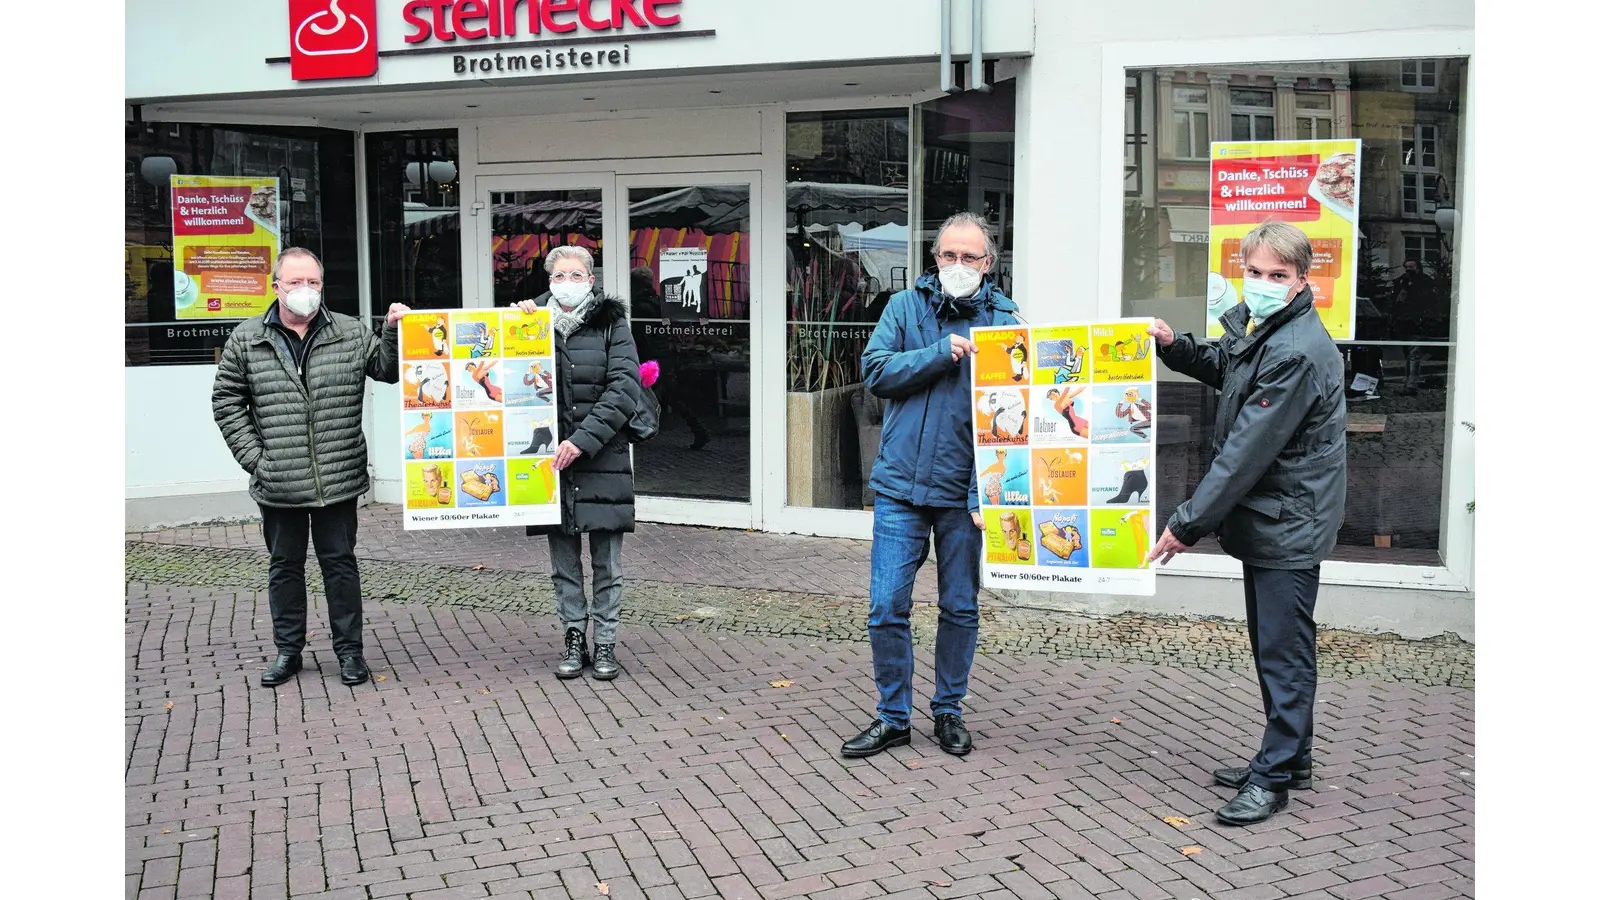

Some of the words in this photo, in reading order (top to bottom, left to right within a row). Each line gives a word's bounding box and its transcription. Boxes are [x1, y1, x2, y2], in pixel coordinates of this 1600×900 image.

[453, 44, 631, 74] Brotmeisterei
[1217, 170, 1261, 182] Danke,
[1262, 167, 1308, 180] Tschüss
[1220, 185, 1232, 197] &
[1235, 183, 1285, 196] Herzlich
[177, 195, 210, 205] Danke,
[210, 194, 244, 204] Tschüss
[1225, 197, 1307, 212] willkommen!
[180, 206, 189, 216] &
[191, 205, 228, 215] Herzlich
[184, 216, 244, 227] willkommen!
[167, 326, 234, 338] Brotmeis
[645, 325, 733, 336] Brotmeisterei
[800, 328, 874, 339] Brotmeiste
[980, 371, 1007, 380] KAFFEE
[977, 434, 1028, 444] Theaterkunst
[471, 512, 500, 520] Plakate
[990, 571, 1017, 580] Wiener
[1018, 573, 1050, 582] 50/60er
[1051, 575, 1082, 584] Plakate
